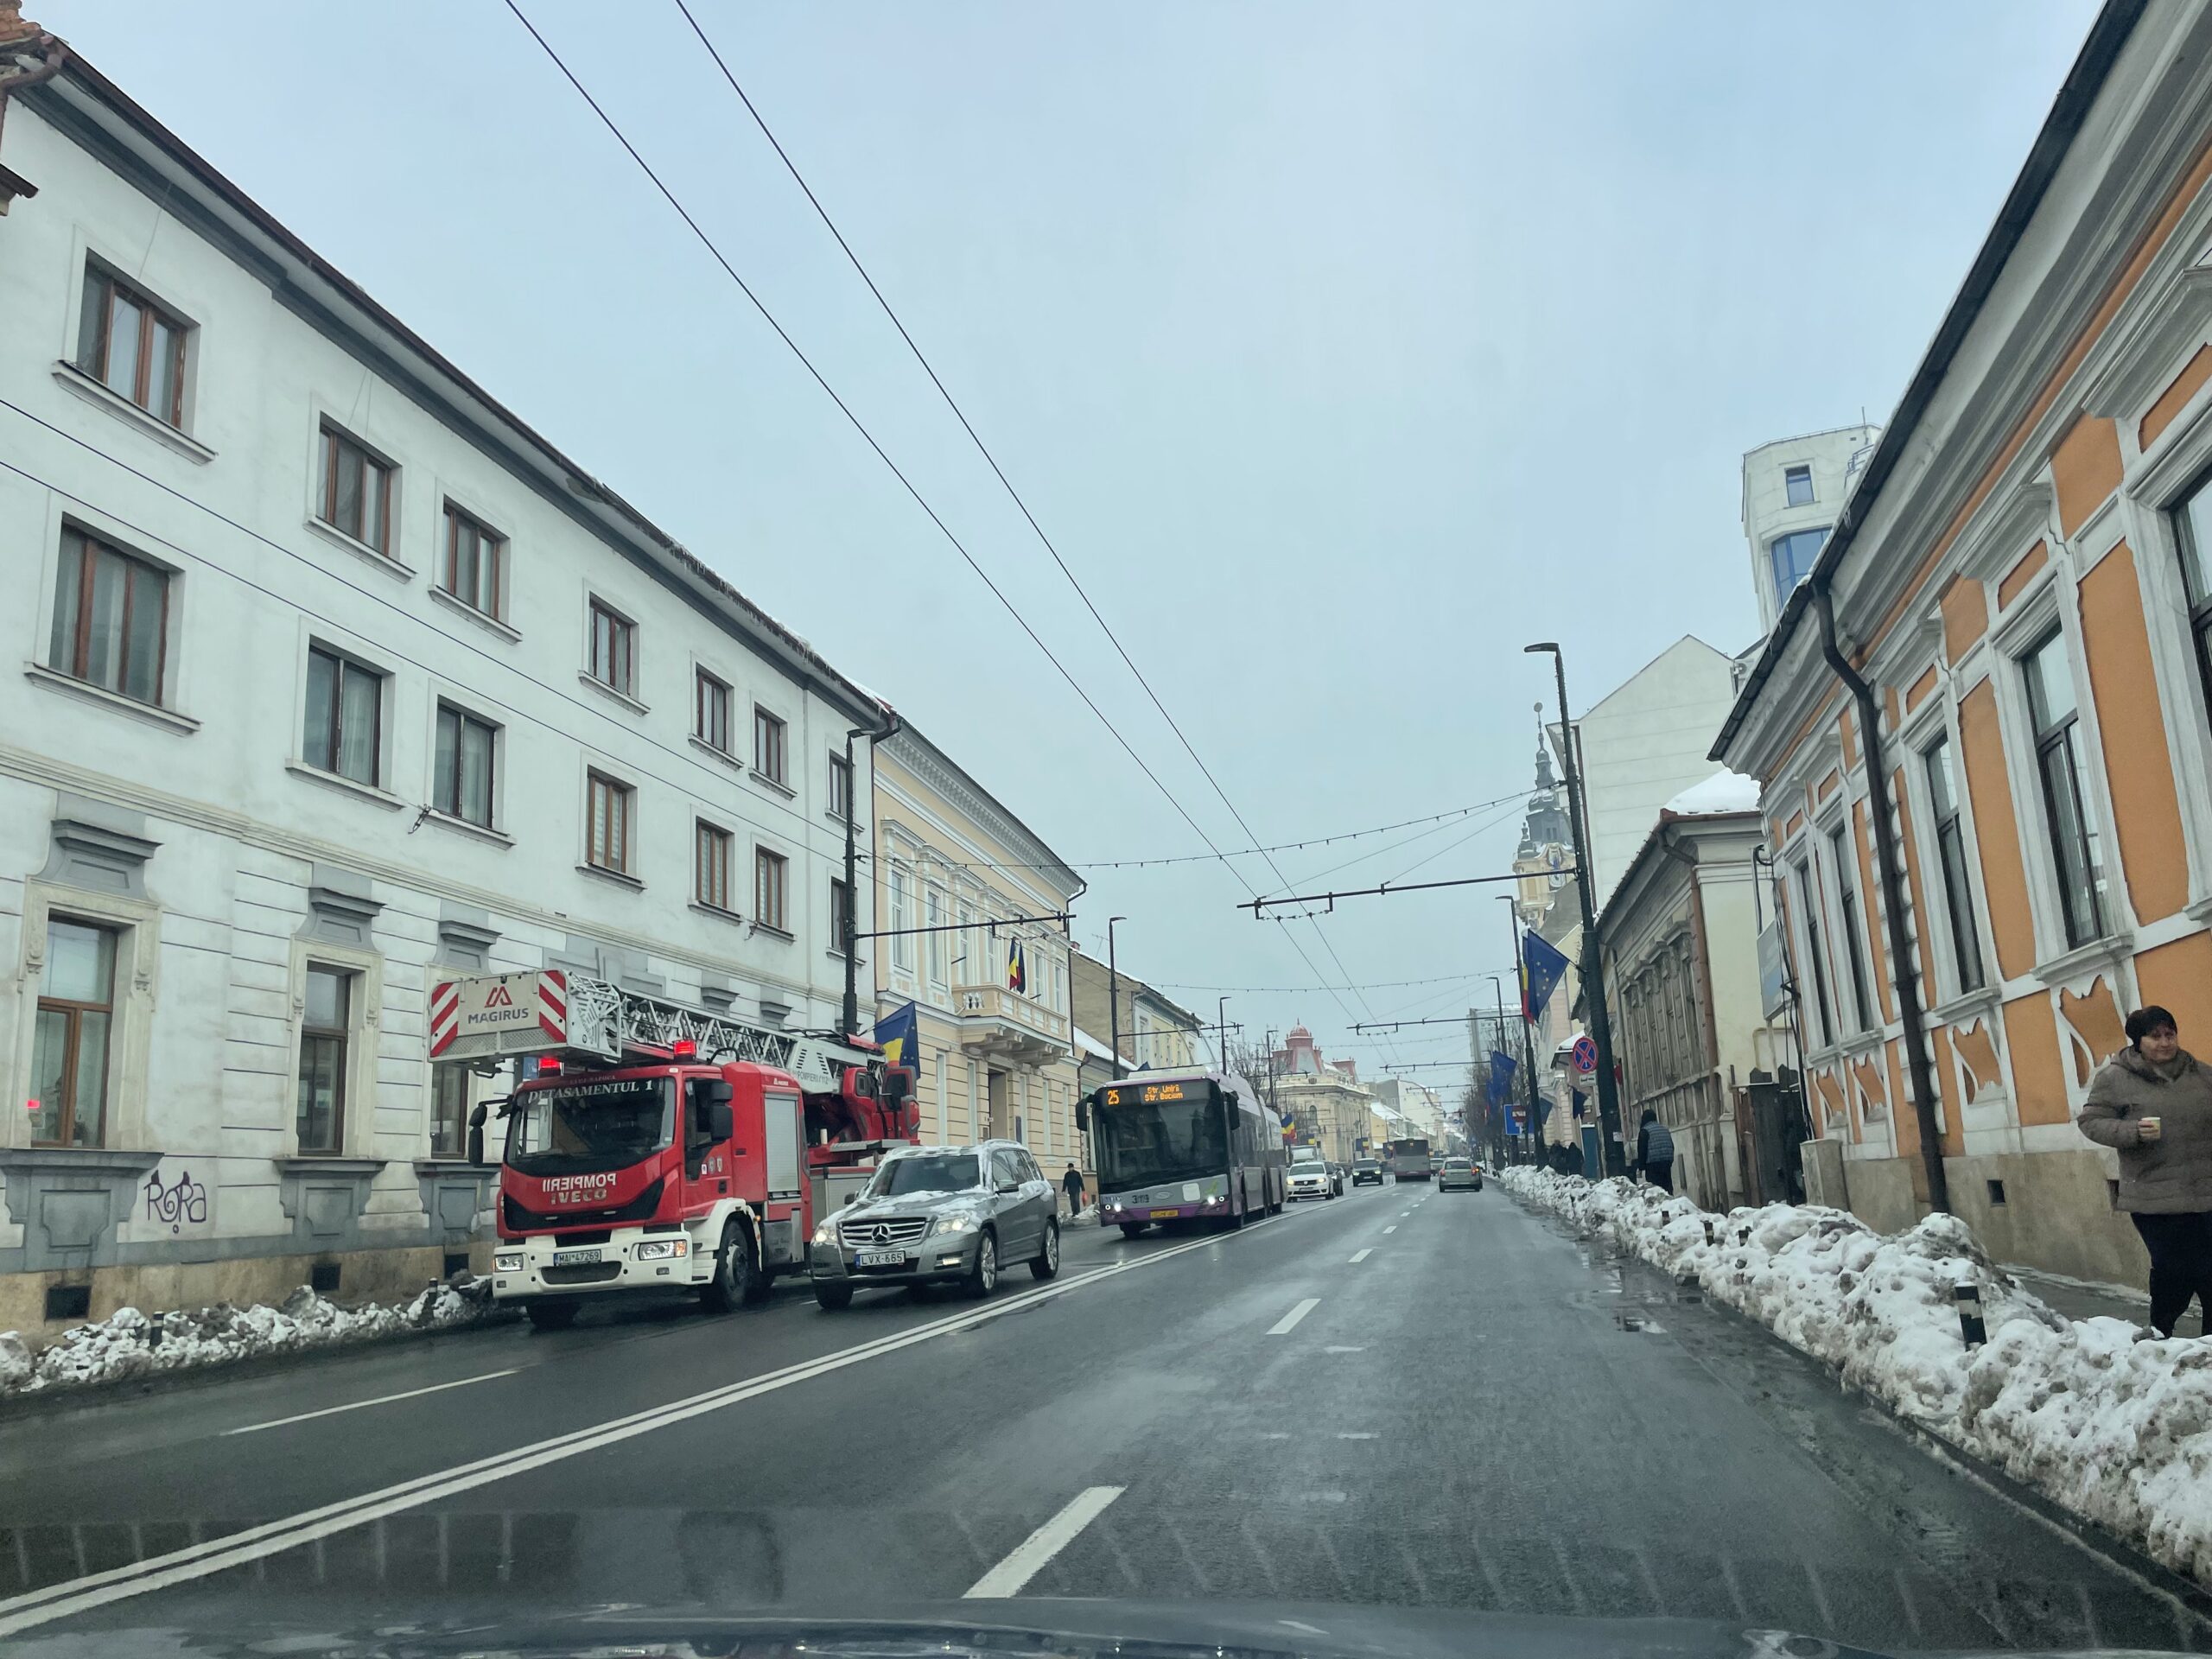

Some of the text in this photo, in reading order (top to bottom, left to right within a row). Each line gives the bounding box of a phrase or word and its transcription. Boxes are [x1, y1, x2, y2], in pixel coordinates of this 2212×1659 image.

[467, 1007, 529, 1024] MAGIRUS
[645, 1080, 653, 1090] 1
[1107, 1090, 1120, 1105] 25
[551, 1188, 607, 1205] IVECO
